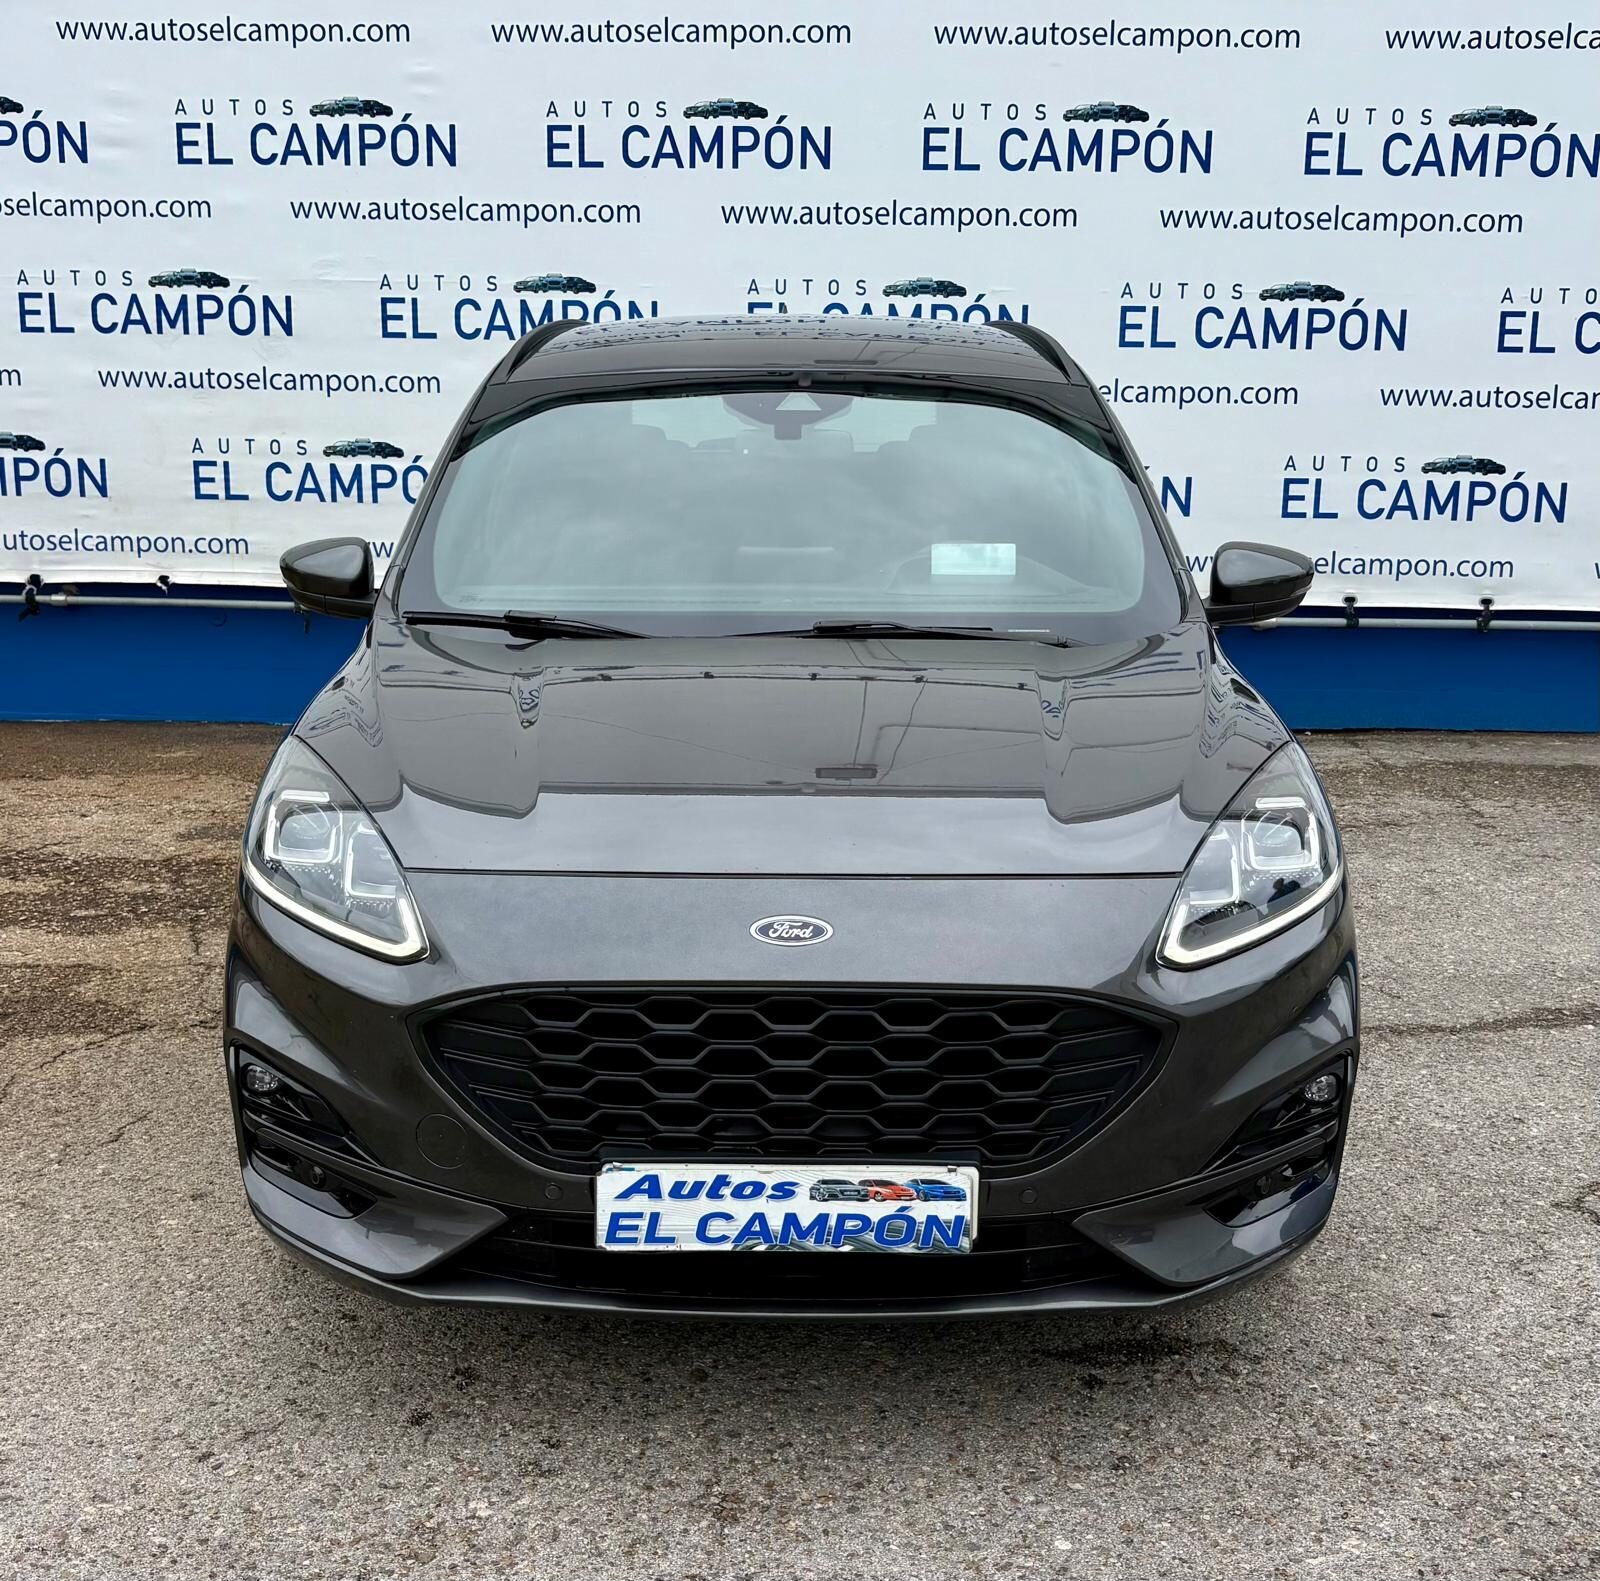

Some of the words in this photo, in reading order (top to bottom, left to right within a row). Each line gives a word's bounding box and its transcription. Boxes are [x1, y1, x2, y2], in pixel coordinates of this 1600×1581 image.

[55, 15, 410, 49] www.autoselcampon.com
[490, 16, 851, 50] www.autoselcampon.com
[933, 19, 1300, 54] www.autoselcampon.com
[174, 98, 294, 116] AUTOS
[546, 100, 667, 118] AUTOS
[923, 102, 1047, 121] AUTOS
[1306, 107, 1433, 126] AUTOS
[175, 122, 234, 165] EL
[250, 113, 457, 167] CAMPÓN
[546, 124, 605, 169] EL
[621, 115, 832, 170] CAMPÓN
[922, 126, 981, 171] EL
[999, 118, 1213, 174] CAMPÓN
[1303, 131, 1363, 176] EL
[1382, 123, 1600, 178] CAMPÓN
[0, 191, 212, 225] selcampon.com
[289, 195, 641, 229] www.autoselcampon.com
[720, 199, 1078, 233] www.autoselcampon.com
[1159, 204, 1523, 239] www.autoselcampon.com
[16, 269, 133, 287] AUTOS
[379, 273, 498, 292] AUTOS
[747, 278, 867, 296] AUTOS
[1120, 282, 1243, 300] AUTOS
[17, 291, 76, 334] EL
[90, 285, 294, 337] CAMPÓN
[380, 296, 438, 340] EL
[1118, 305, 1177, 349] EL
[1194, 298, 1408, 352] CAMPÓN
[1496, 310, 1556, 354] EL
[97, 365, 441, 398] www.autoselcampon.com
[191, 437, 308, 456] AUTOS
[192, 459, 250, 501] EL
[1283, 455, 1405, 473] AUTOS
[1280, 477, 1339, 520] EL
[1357, 471, 1568, 524] CAMPÓN
[768, 921, 814, 938] Ford
[614, 1173, 799, 1201] Autos
[605, 1211, 674, 1245] EL
[695, 1206, 965, 1248] CAMPÓN
